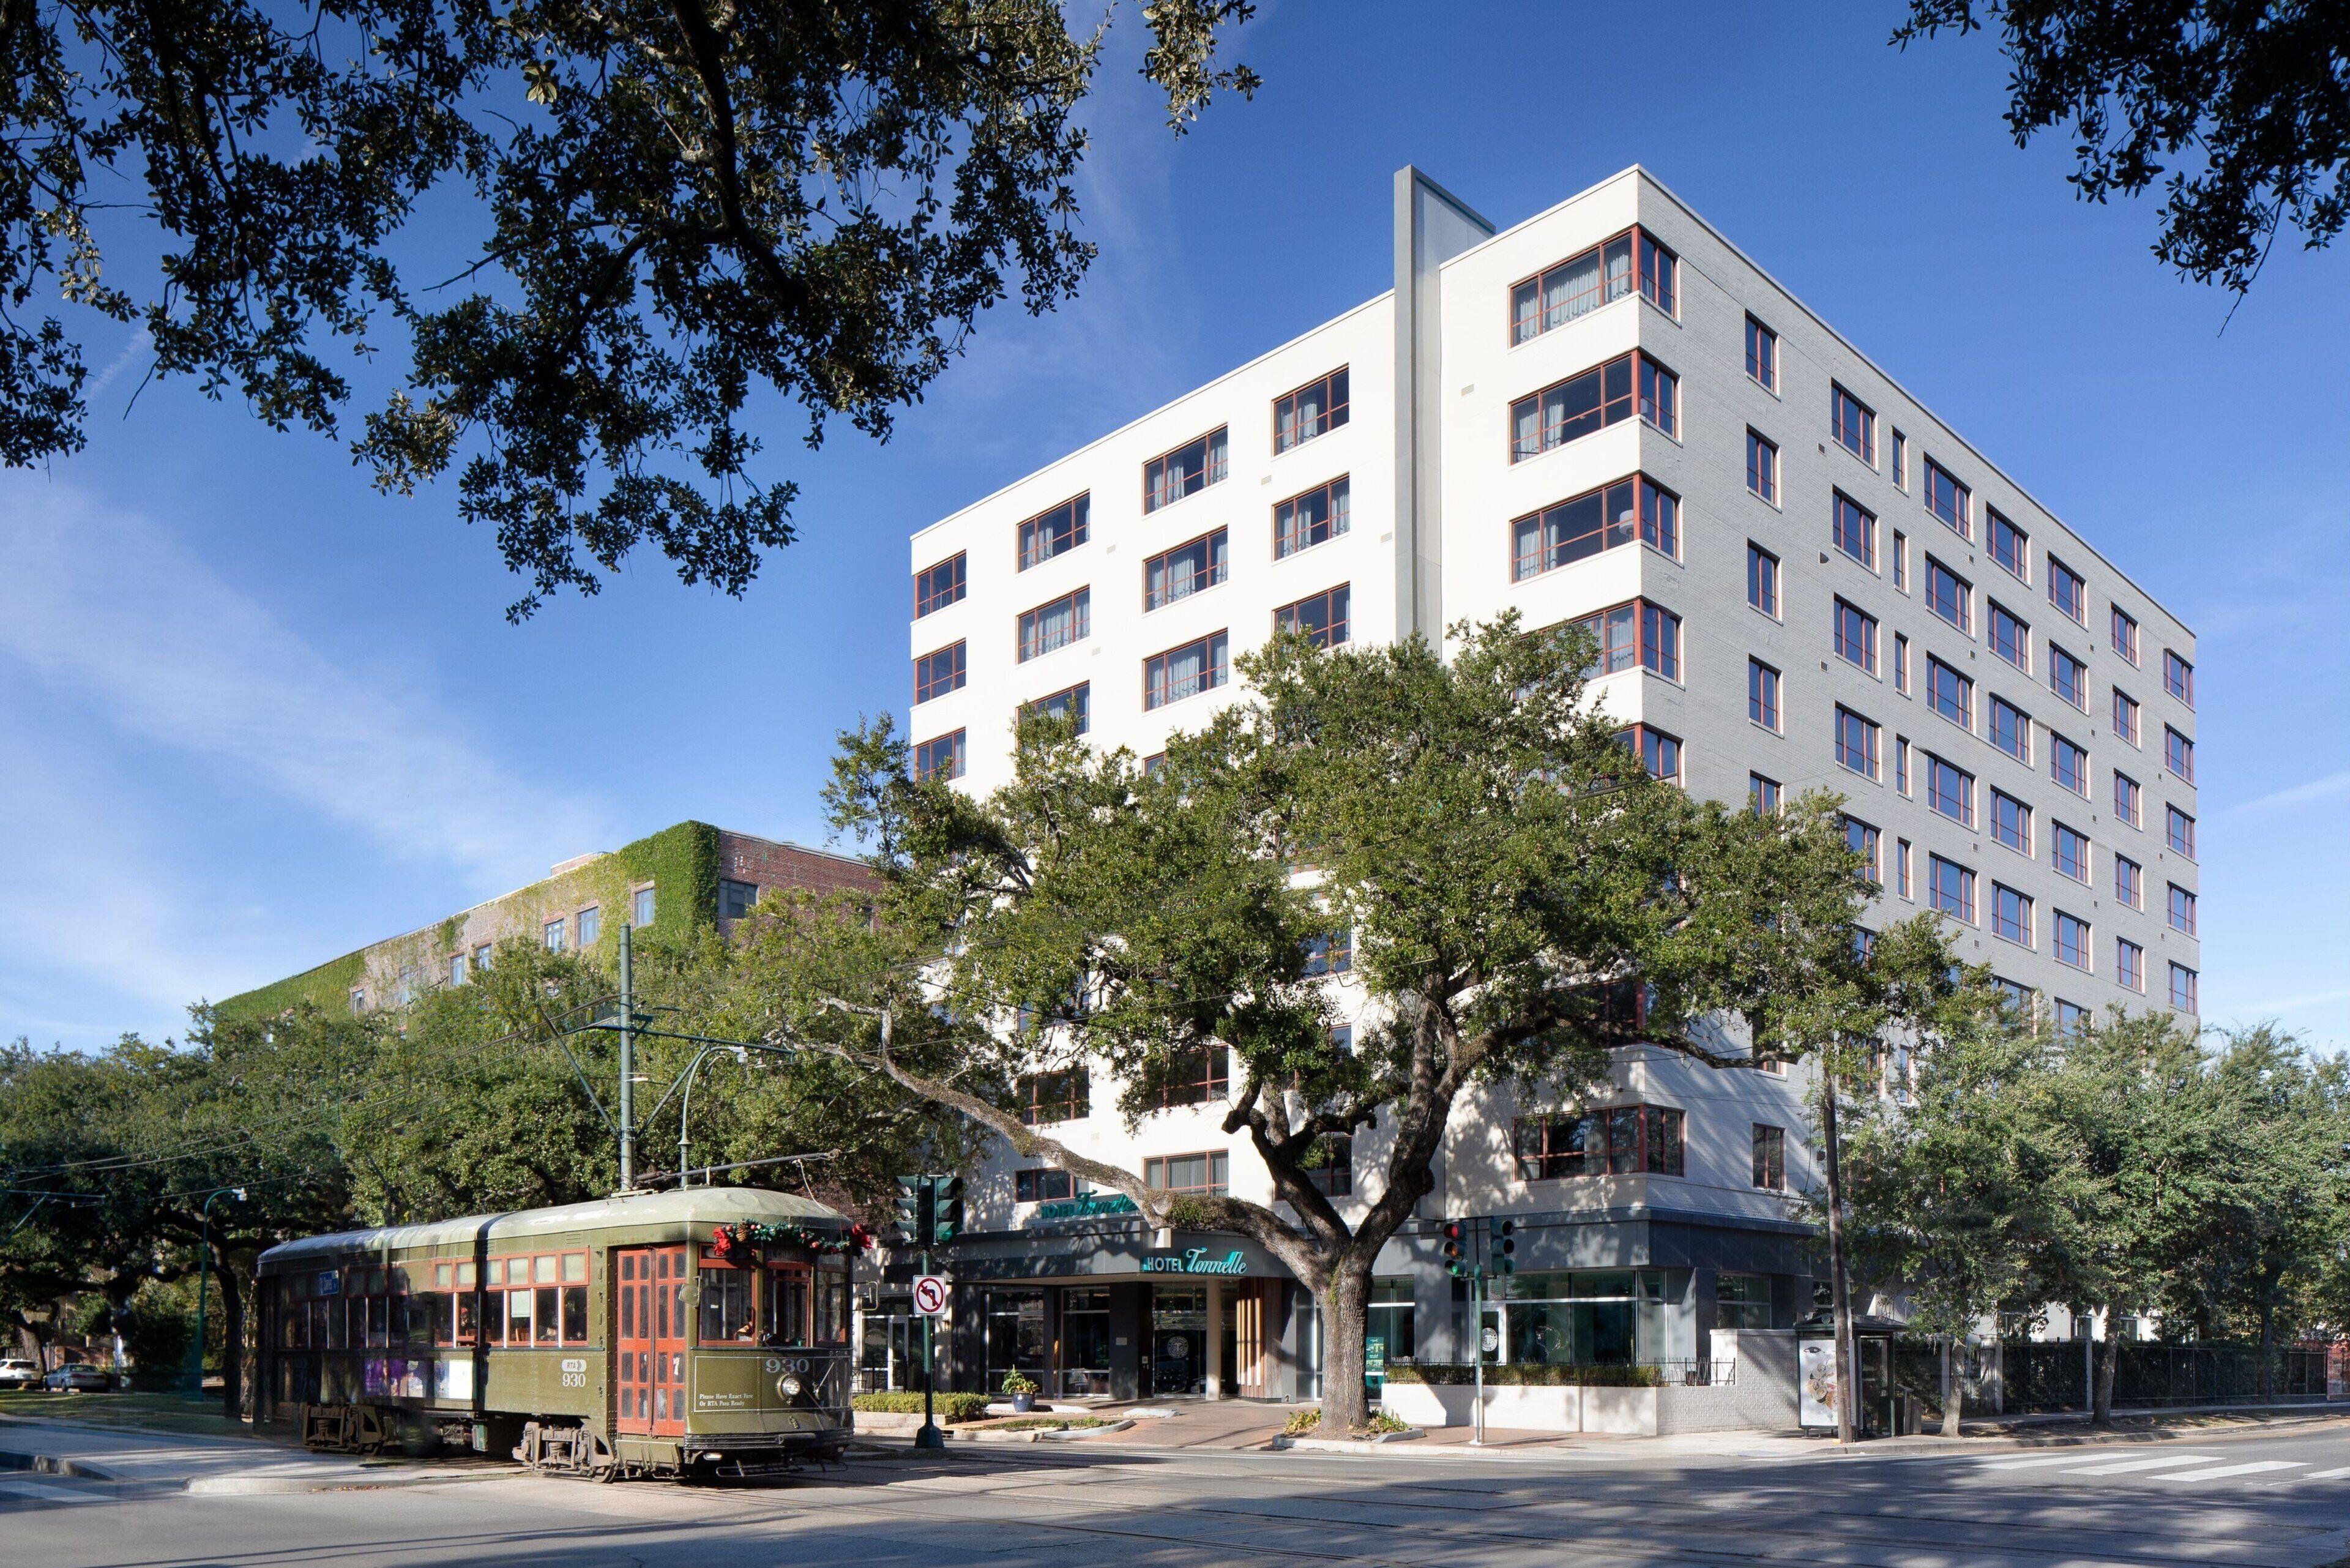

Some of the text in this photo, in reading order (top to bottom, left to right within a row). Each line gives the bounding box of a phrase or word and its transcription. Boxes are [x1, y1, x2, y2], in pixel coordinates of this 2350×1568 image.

[1041, 1203, 1075, 1219] HOTEL
[1143, 1247, 1247, 1274] HOTEL Tonnelle
[766, 1358, 809, 1373] 930
[562, 1373, 586, 1387] 930
